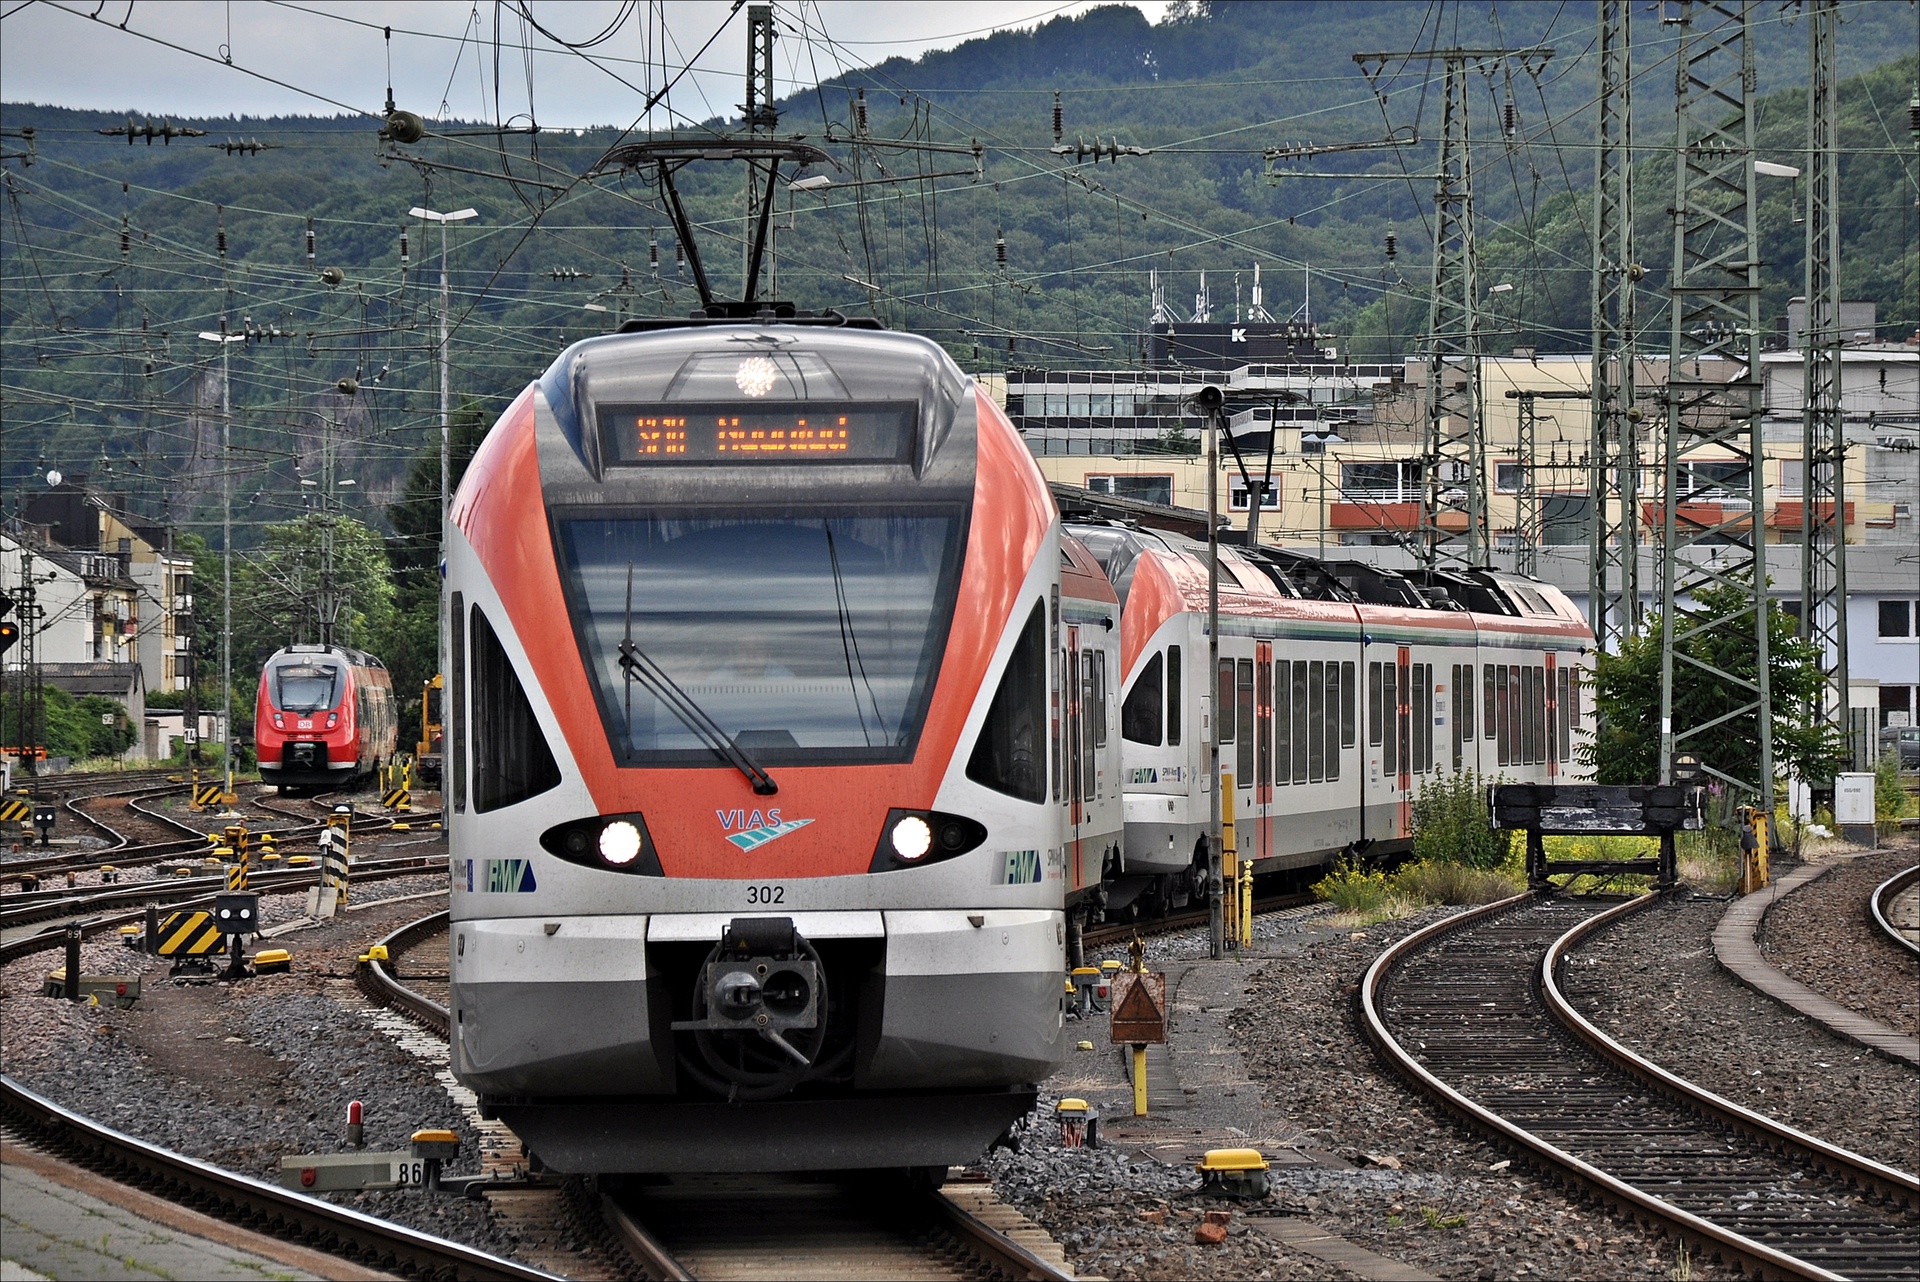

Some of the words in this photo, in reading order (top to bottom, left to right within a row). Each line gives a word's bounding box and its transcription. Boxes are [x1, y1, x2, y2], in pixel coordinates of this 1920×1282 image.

[1231, 328, 1247, 342] K
[185, 730, 195, 742] 14
[715, 808, 783, 830] VIAS
[746, 885, 785, 905] 302
[399, 1162, 422, 1185] 86
